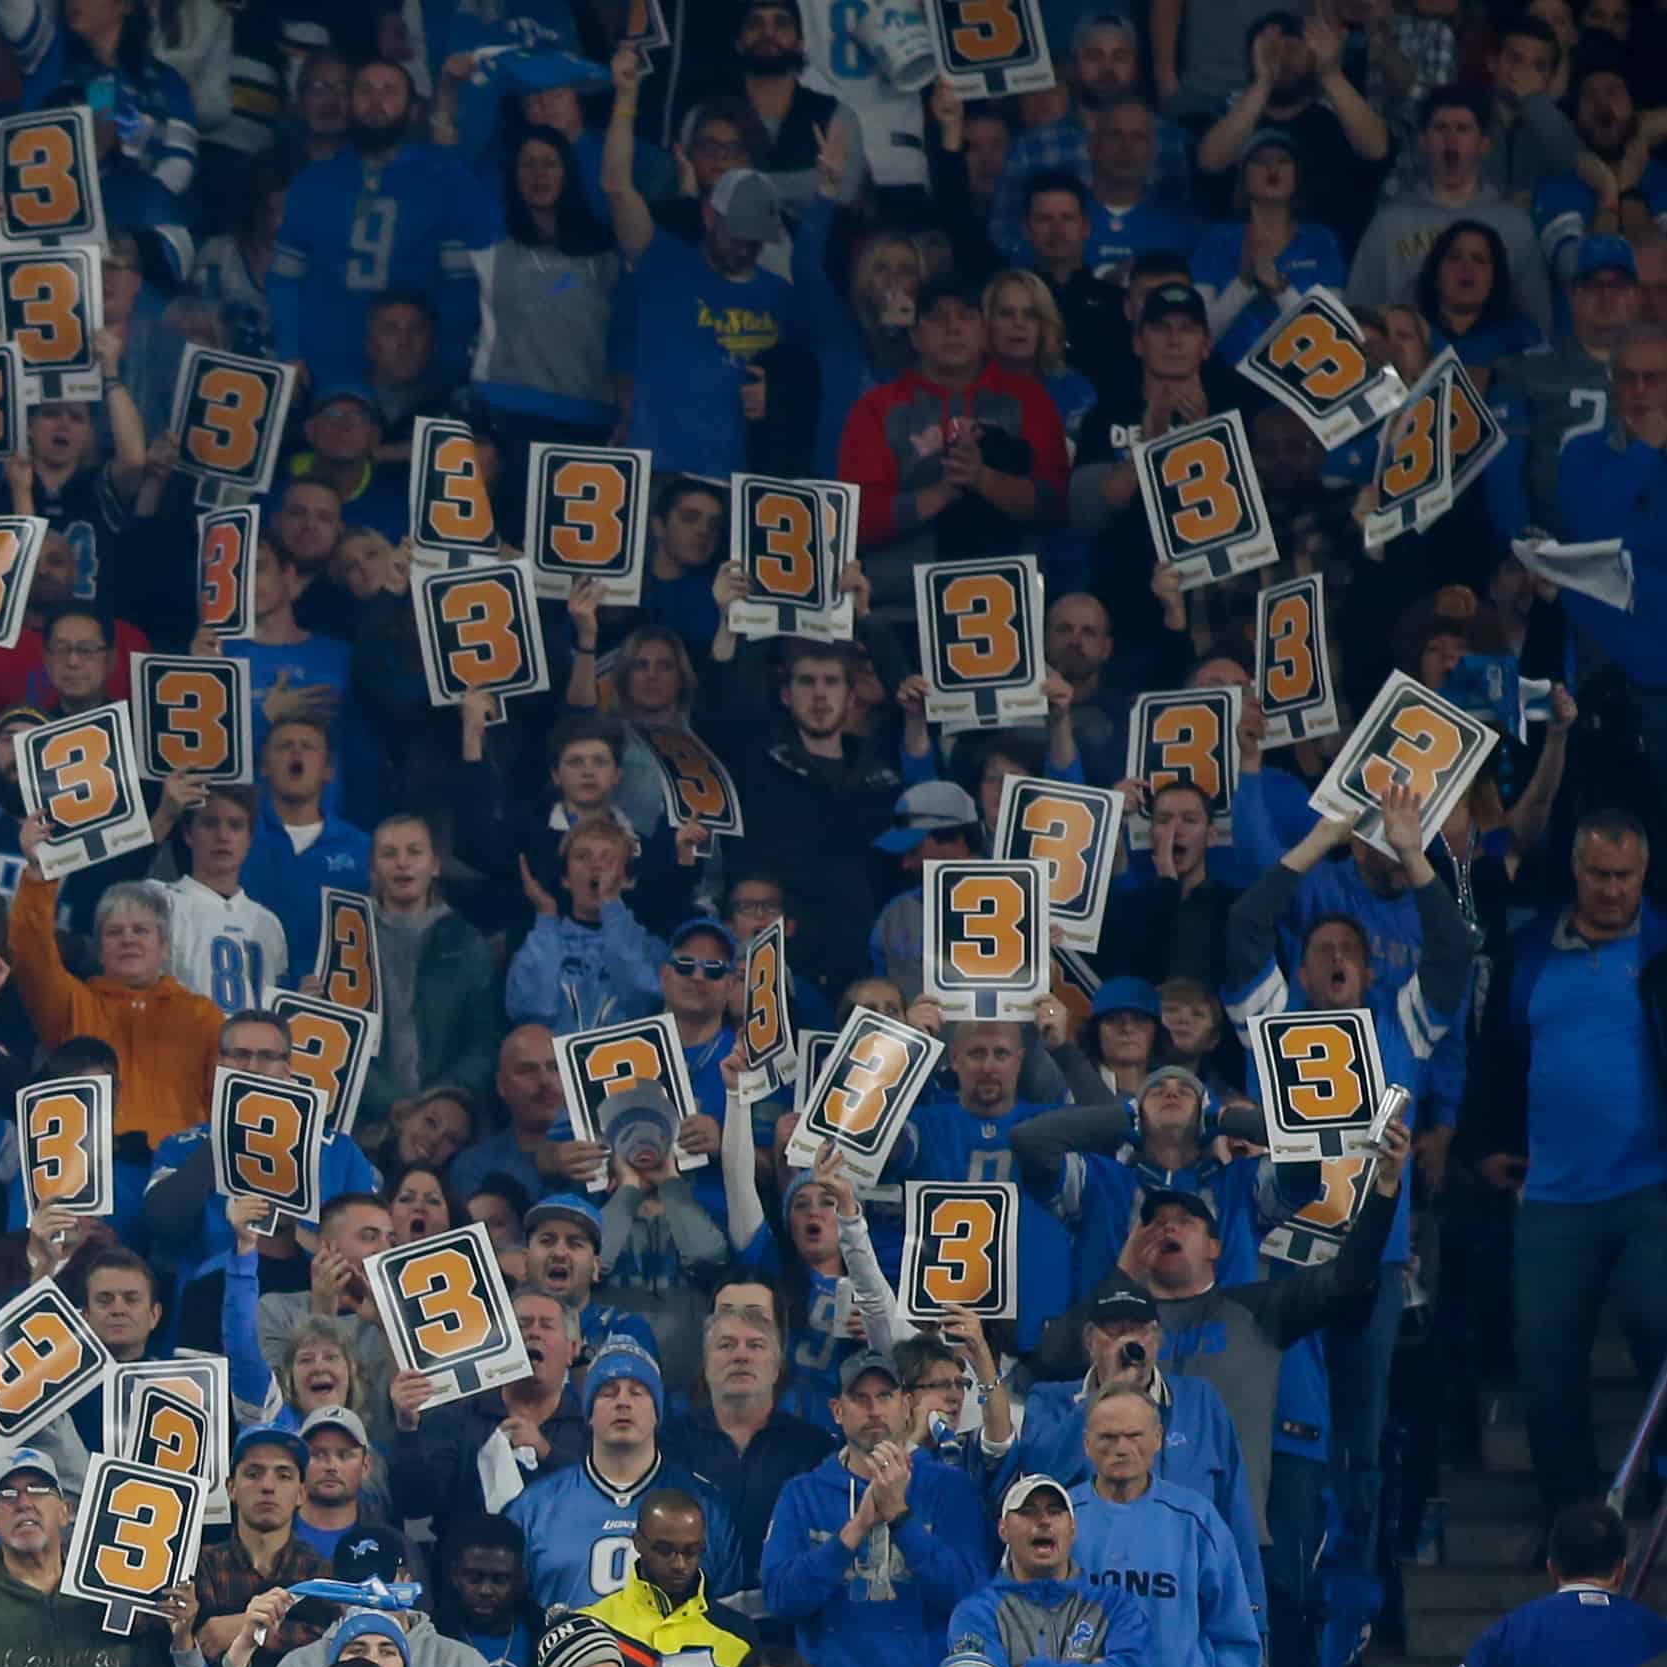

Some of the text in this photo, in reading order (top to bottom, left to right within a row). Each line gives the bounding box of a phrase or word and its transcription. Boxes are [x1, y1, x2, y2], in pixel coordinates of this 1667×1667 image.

[8, 127, 78, 226] 3
[346, 196, 397, 290] 9
[11, 264, 82, 361] 3
[551, 463, 625, 564] 3
[1162, 438, 1241, 542] 3
[756, 494, 815, 595] 3
[442, 581, 521, 688] 3
[944, 575, 1018, 679] 3
[157, 673, 227, 770] 3
[43, 727, 117, 826] 3
[210, 933, 263, 1012] 81
[951, 878, 1024, 976] 3
[1280, 1025, 1362, 1120] 3
[236, 1093, 301, 1195] 3
[924, 1200, 995, 1304] 3
[400, 1250, 489, 1356] 3
[97, 1481, 182, 1593] 3
